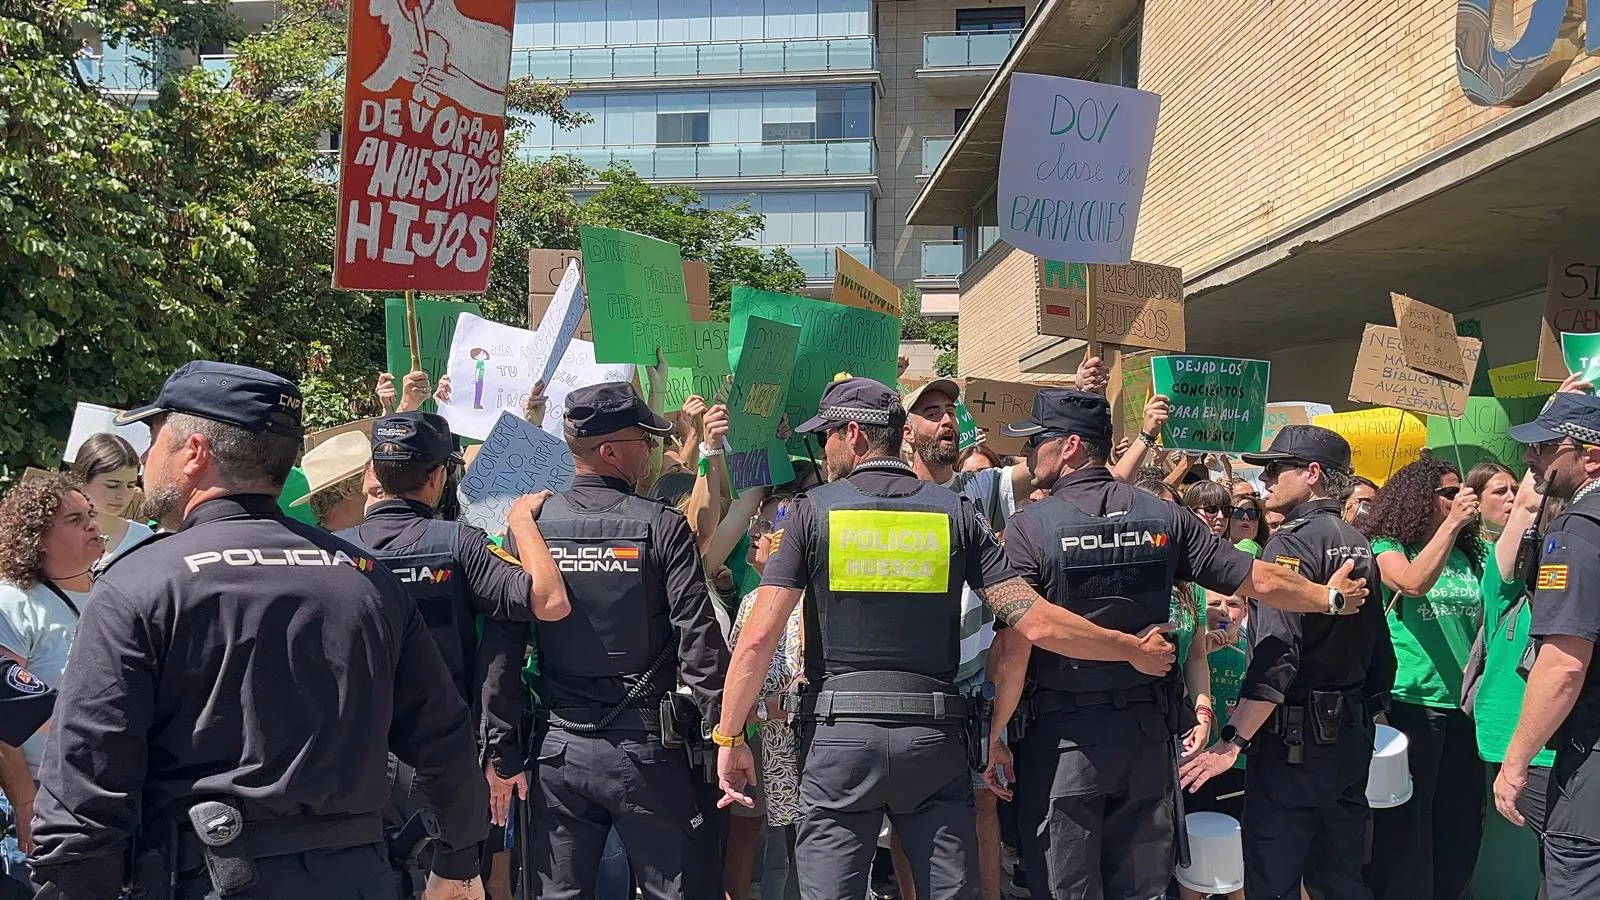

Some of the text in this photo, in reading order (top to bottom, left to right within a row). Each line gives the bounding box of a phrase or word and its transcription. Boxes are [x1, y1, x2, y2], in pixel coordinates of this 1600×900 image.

[1050, 94, 1120, 144] DOY
[367, 140, 500, 210] NUESTROS
[1036, 142, 1137, 186] clase en
[1010, 195, 1127, 243] BARRACONES
[345, 199, 492, 272] HIJOS
[1102, 262, 1180, 304] RECURSOS
[1075, 299, 1171, 342] DSCURSOS
[1176, 359, 1242, 376] DEJAD LOS
[1172, 382, 1245, 400] CONCIERTOS
[1374, 380, 1428, 397] AULA DE
[1168, 404, 1250, 422] PARA EL AULA
[1396, 396, 1459, 412] ESPAÑOL
[1172, 427, 1189, 438] DE
[839, 528, 940, 553] POLICIA
[1061, 530, 1155, 552] POLICIA
[184, 548, 356, 573] POLICIA
[559, 559, 639, 572] CIONAL
[846, 558, 934, 578] HUESCA
